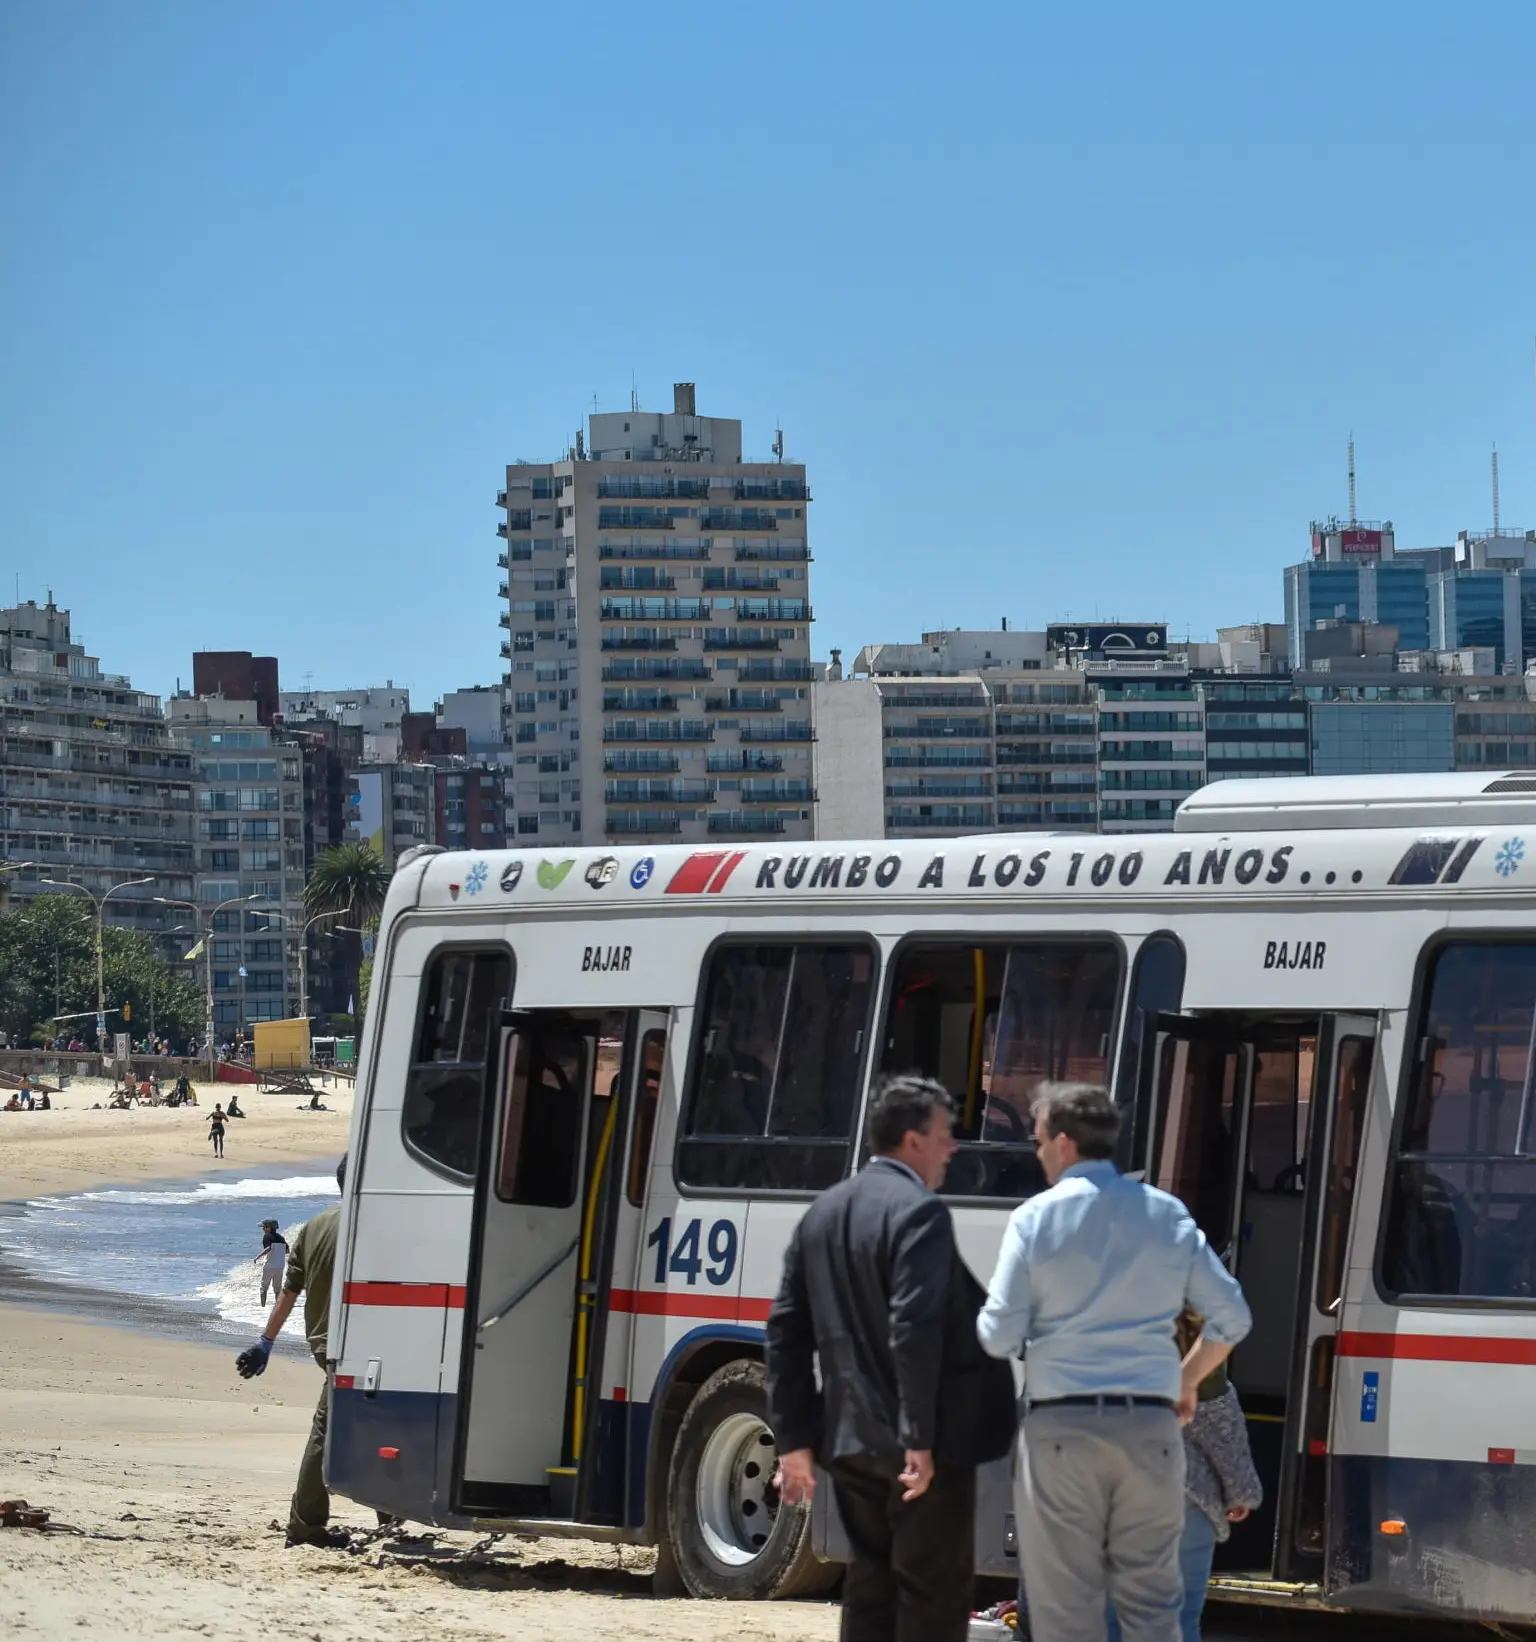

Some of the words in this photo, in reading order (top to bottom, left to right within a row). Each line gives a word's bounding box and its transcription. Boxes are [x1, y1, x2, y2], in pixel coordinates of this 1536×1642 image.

[755, 852, 902, 889] RUMBO
[917, 852, 946, 889] A
[967, 850, 1052, 888] LOS
[1066, 850, 1143, 887] 100
[581, 945, 632, 971] BAJAR
[1263, 940, 1326, 969] BAJAR
[648, 1217, 738, 1286] 149
